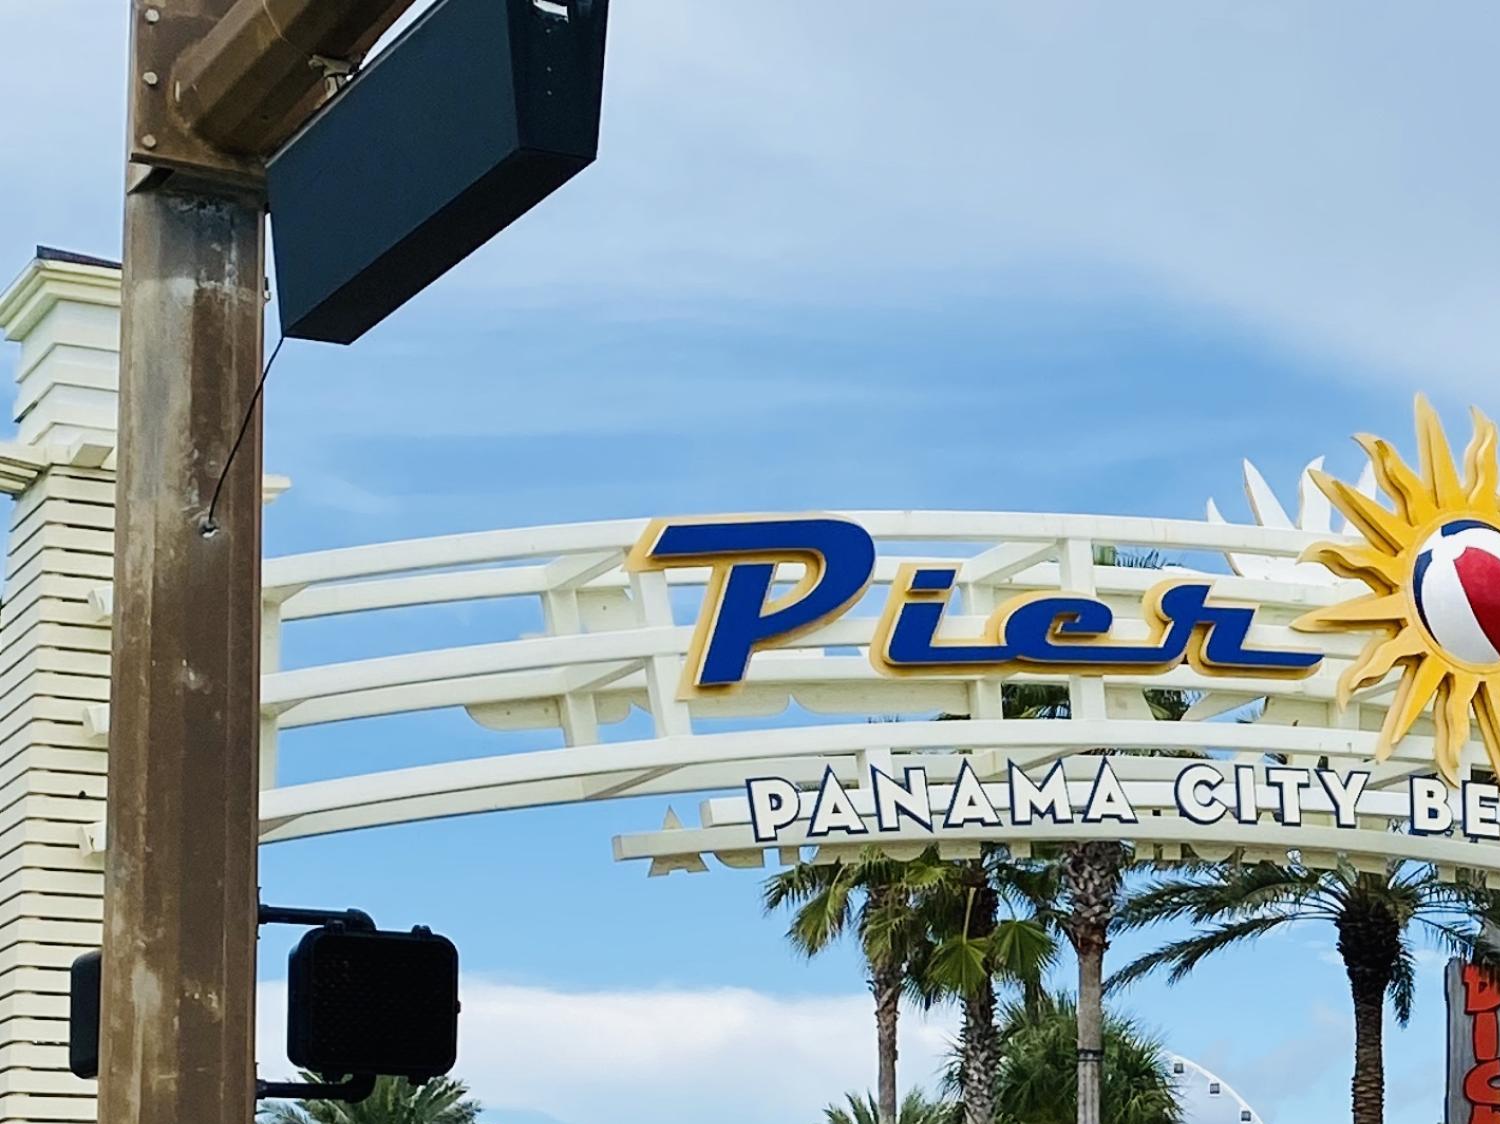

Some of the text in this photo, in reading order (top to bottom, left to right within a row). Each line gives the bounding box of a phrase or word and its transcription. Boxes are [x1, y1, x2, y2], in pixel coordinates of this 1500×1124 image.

[640, 515, 1324, 692] Pier
[746, 755, 1138, 843] PANAMA
[1173, 761, 1371, 829] CITY
